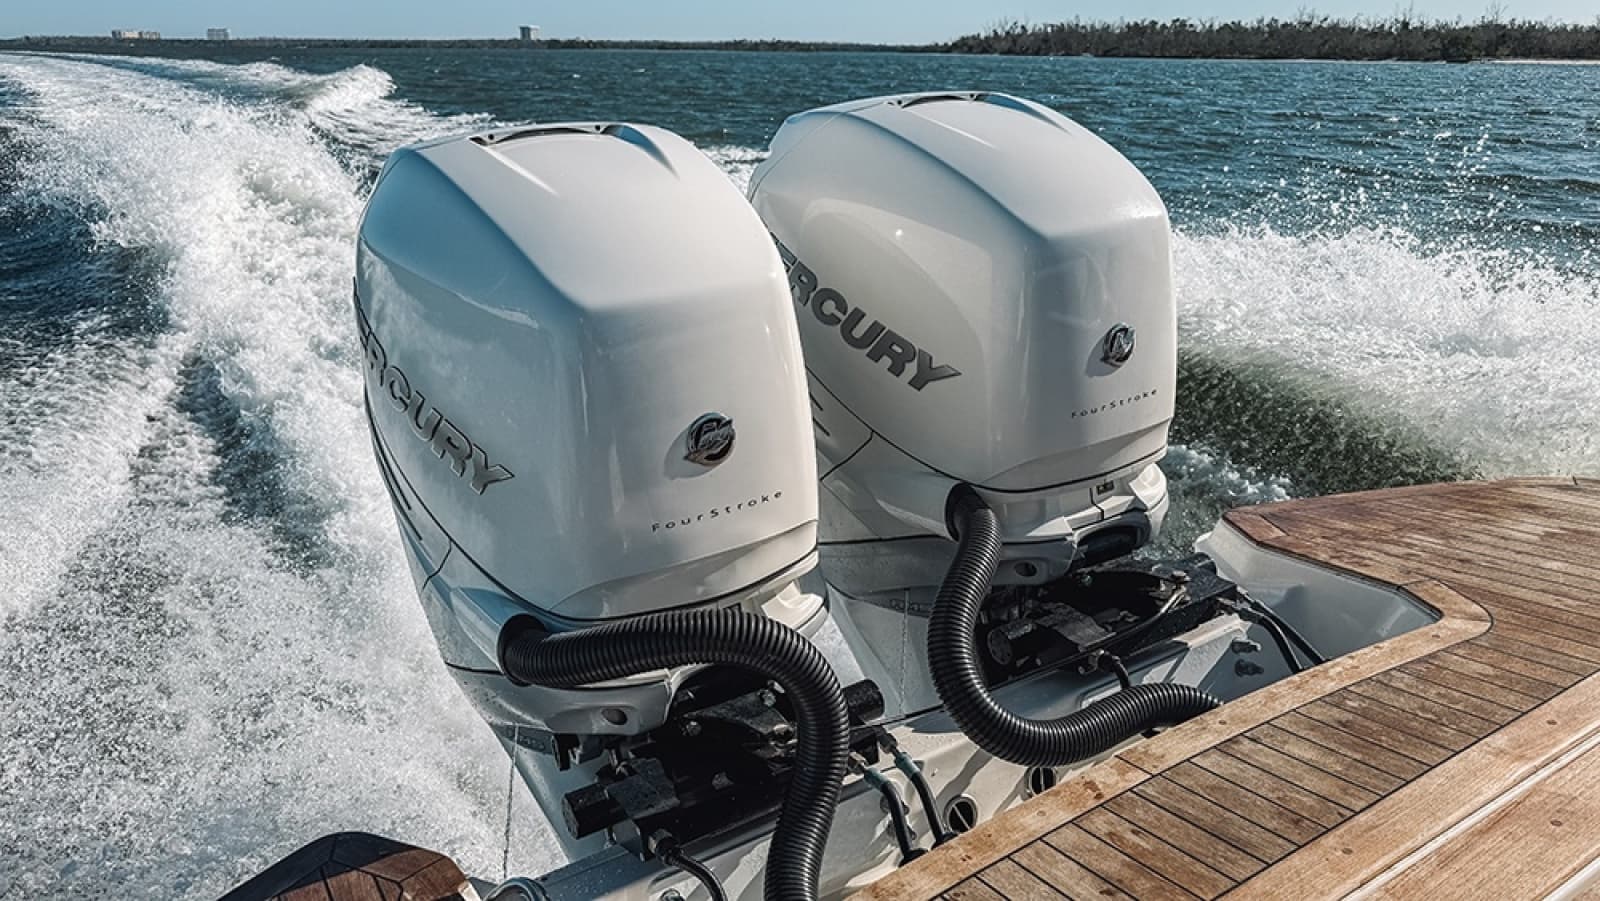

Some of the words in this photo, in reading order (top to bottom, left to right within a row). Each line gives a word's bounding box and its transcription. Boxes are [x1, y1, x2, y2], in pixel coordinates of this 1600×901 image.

[770, 231, 962, 391] RCURY
[353, 277, 515, 495] RCURY
[1071, 389, 1157, 419] FourStroke
[651, 491, 782, 532] FourStroke
